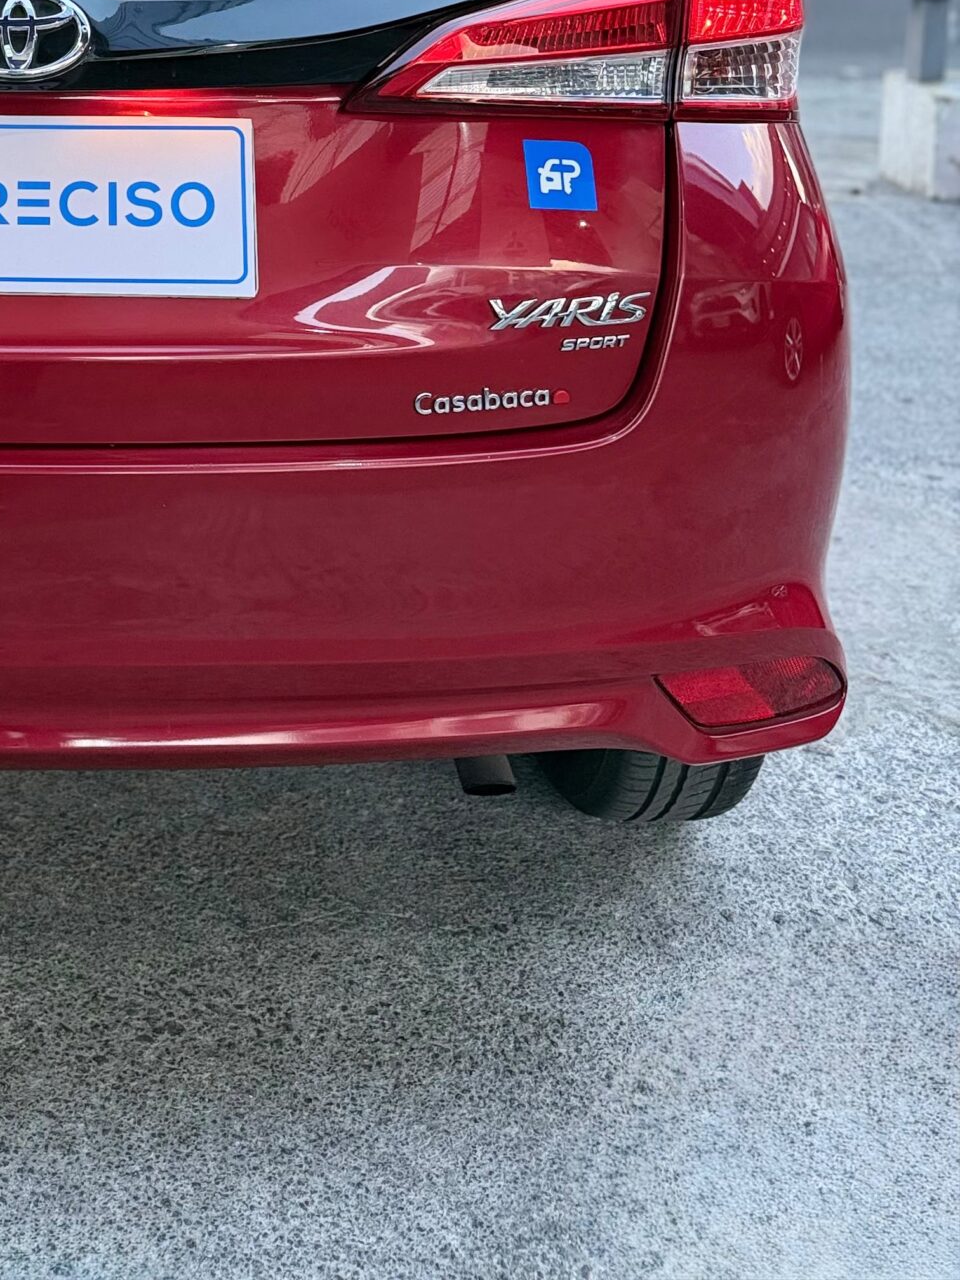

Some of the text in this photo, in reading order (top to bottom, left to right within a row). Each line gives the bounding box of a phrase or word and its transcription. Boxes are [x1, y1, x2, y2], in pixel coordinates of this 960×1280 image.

[489, 291, 651, 331] YARIS
[560, 334, 631, 352] SPORT
[414, 387, 551, 416] Casabaca
